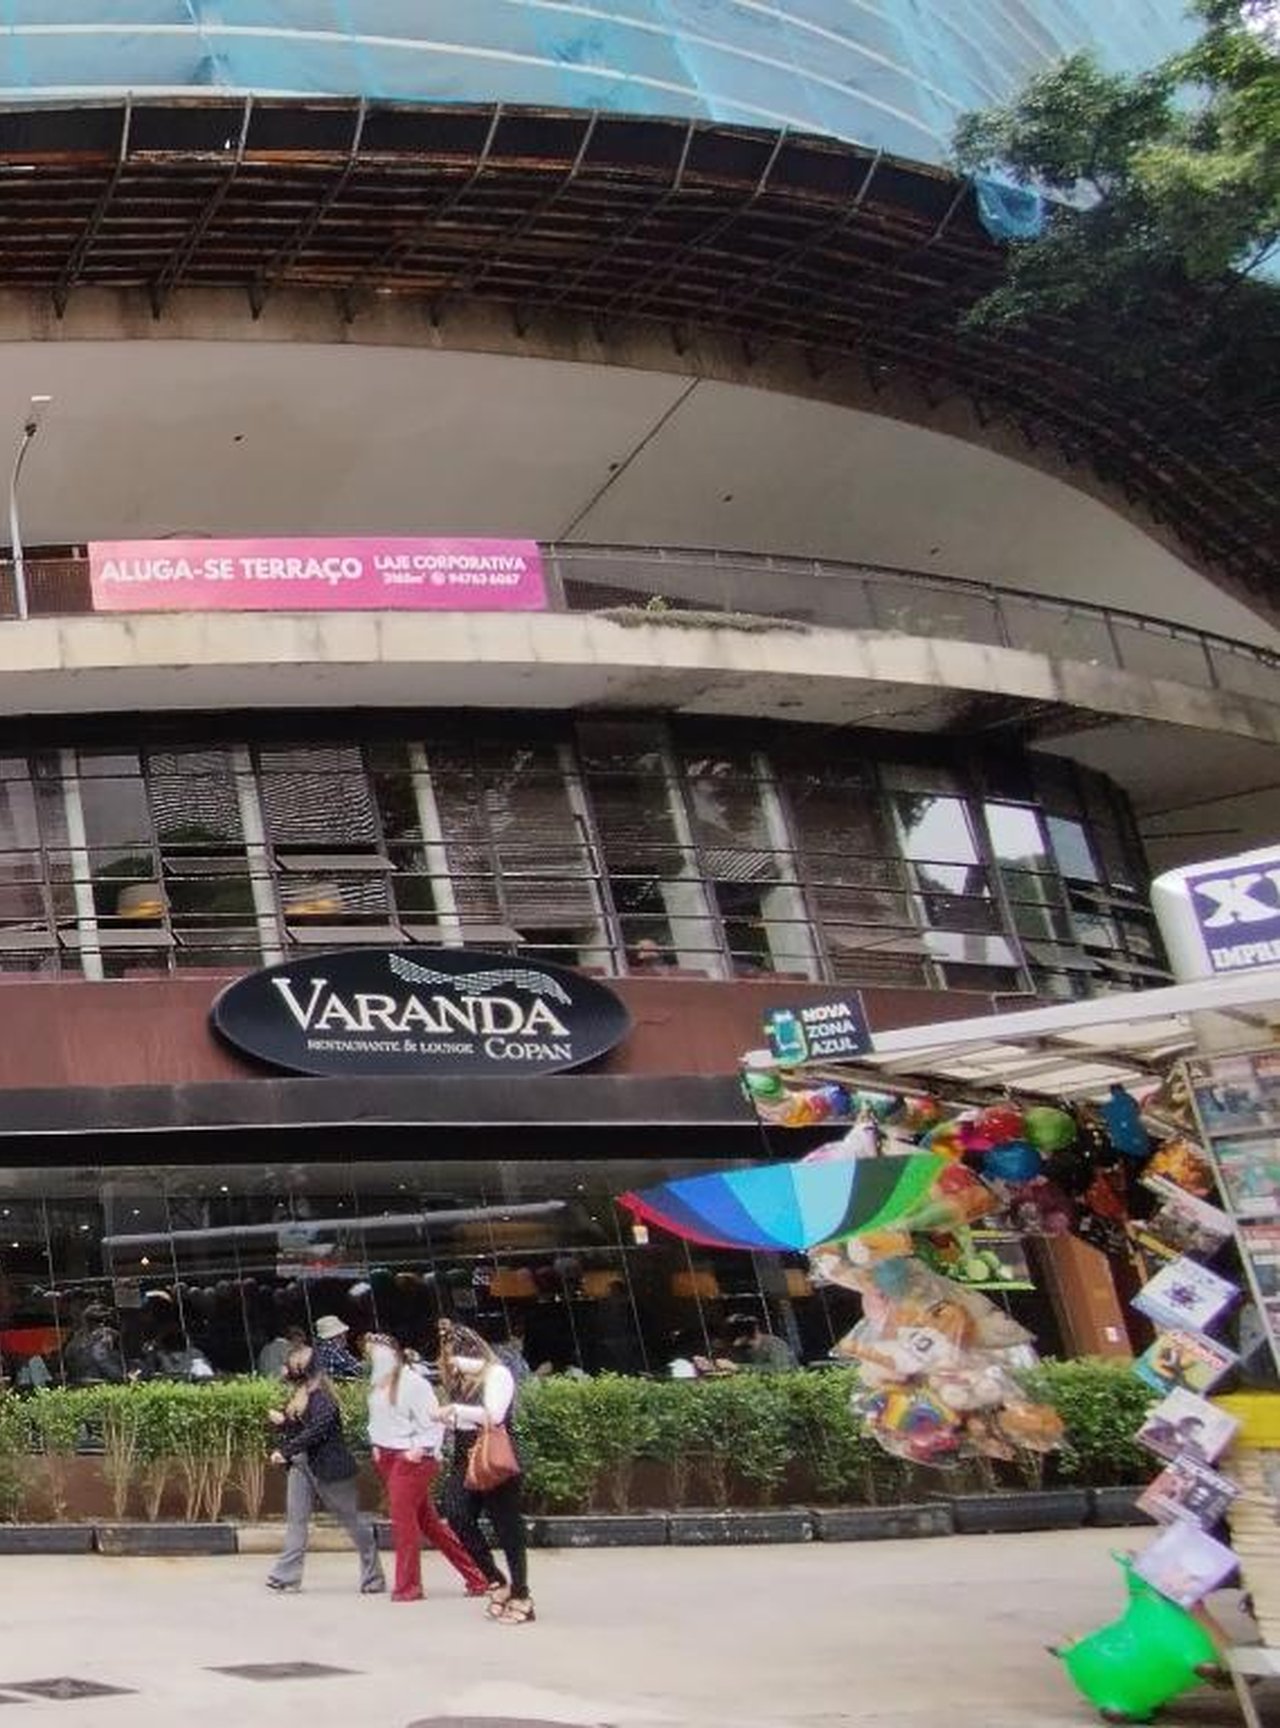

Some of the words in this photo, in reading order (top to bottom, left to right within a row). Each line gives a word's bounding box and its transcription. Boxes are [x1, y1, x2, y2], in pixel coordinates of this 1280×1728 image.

[100, 557, 234, 582] ALUGA-SE
[239, 556, 363, 585] TERRAÇO
[373, 554, 410, 570] LAJE
[413, 555, 527, 572] CORPORATIVA
[271, 977, 570, 1035] VARANDA
[801, 1002, 851, 1022] NOVA
[806, 1019, 856, 1038] ZONA
[403, 1039, 417, 1052] &
[420, 1042, 475, 1054] LOUNGE
[811, 1037, 859, 1056] AZUL
